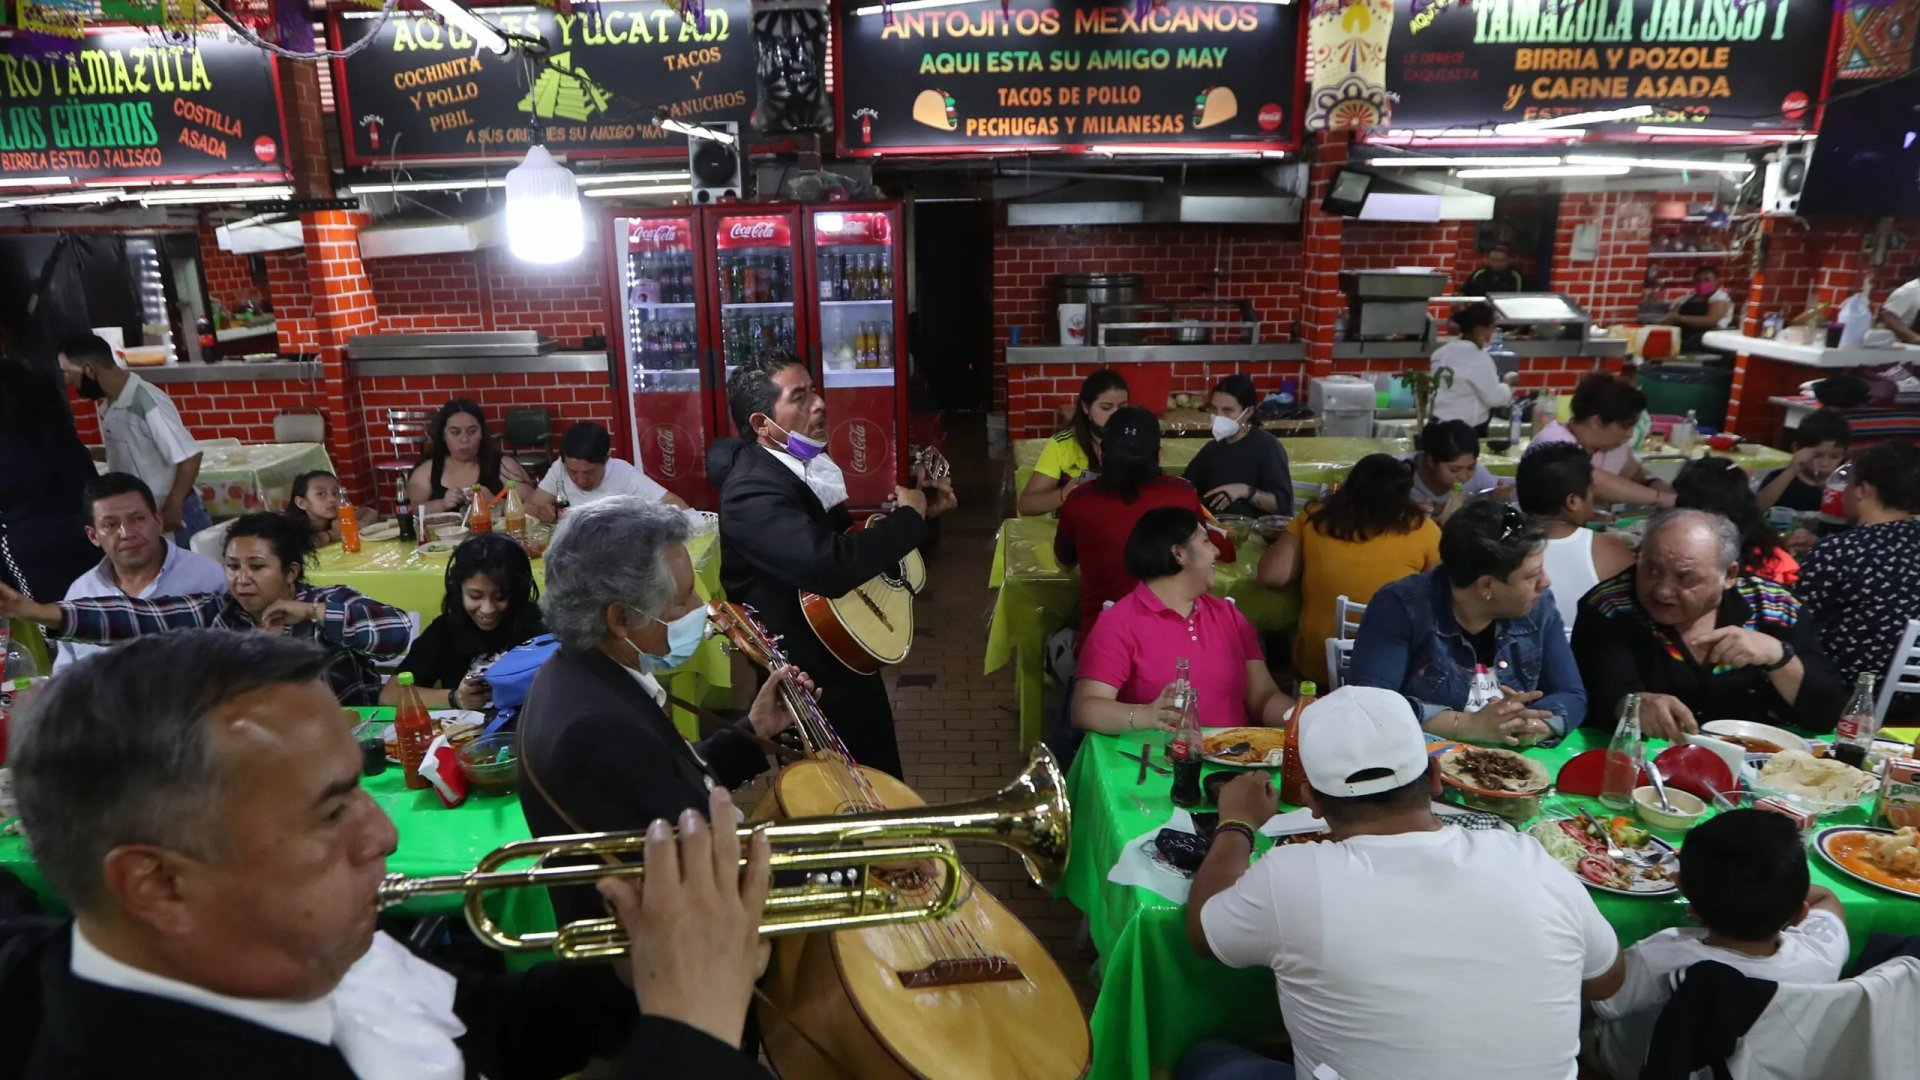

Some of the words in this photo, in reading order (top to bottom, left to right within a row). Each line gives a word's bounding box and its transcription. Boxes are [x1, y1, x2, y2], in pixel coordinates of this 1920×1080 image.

[392, 16, 488, 51] AQU
[554, 8, 730, 46] YUCATAN
[881, 8, 1060, 40] ANTOJITOS
[1074, 4, 1258, 34] MEXICANOS
[1472, 0, 1633, 44] TAMAZULA
[1640, 0, 1767, 42] JALISCO
[0, 54, 42, 97] RO
[44, 46, 212, 96] TAMAZULA
[663, 46, 721, 71] TACOS
[919, 52, 979, 74] AQUI
[987, 51, 1044, 73] ESTA
[1050, 50, 1080, 72] SU
[1086, 48, 1170, 71] AMIGO
[1176, 47, 1228, 69] MAY
[1514, 48, 1599, 71] BIRRIA
[1606, 48, 1624, 70] Y
[1627, 46, 1731, 70] POZOLE
[394, 56, 482, 90] COCHINITA
[691, 72, 703, 90] Y
[410, 91, 422, 111] Y
[427, 82, 479, 108] POLLO
[998, 88, 1051, 107] TACOS
[1059, 87, 1080, 106] DE
[1087, 85, 1141, 104] POLLO
[1503, 83, 1525, 111] y
[1532, 76, 1629, 99] CARNE
[1634, 75, 1731, 99] ASADA
[0, 104, 47, 150] LOS
[50, 98, 159, 149] GÜEROS
[173, 97, 243, 139] COSTILLA
[359, 114, 384, 127] LOCAL
[430, 110, 474, 132] PIBIL
[852, 107, 879, 120] LOCAL
[966, 116, 1060, 137] PECHUGAS
[1065, 116, 1077, 135] Y
[1082, 113, 1185, 134] MILANESAS
[178, 126, 228, 160] ASADA
[467, 130, 475, 144] A
[478, 128, 503, 143] SUS
[506, 126, 566, 142] ORES
[569, 126, 587, 141] SU
[590, 124, 634, 140] AMIGO
[2, 152, 48, 171] BIRRIA
[50, 150, 100, 170] ESTILO
[103, 148, 162, 168] JALISCO
